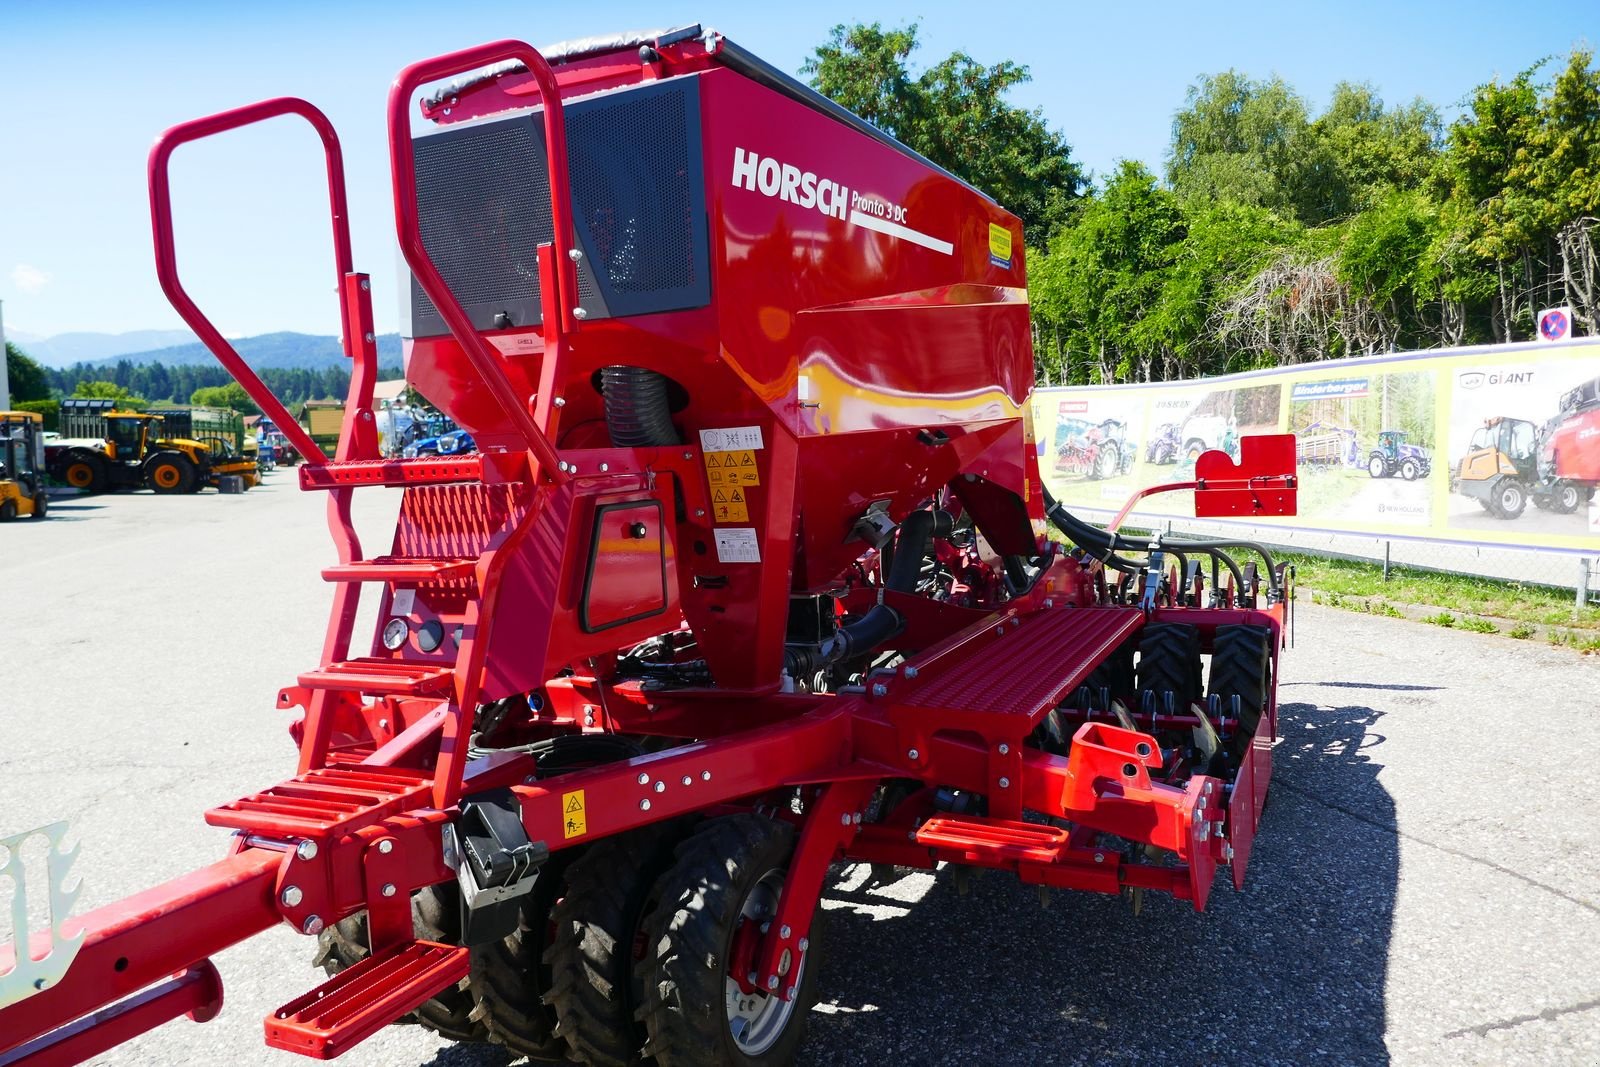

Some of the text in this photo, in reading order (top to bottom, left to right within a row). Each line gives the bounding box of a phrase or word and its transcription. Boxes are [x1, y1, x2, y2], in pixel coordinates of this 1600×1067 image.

[732, 147, 848, 221] HORSCH
[851, 190, 908, 224] Pronto 3 DC
[1293, 382, 1367, 395] Binderberger
